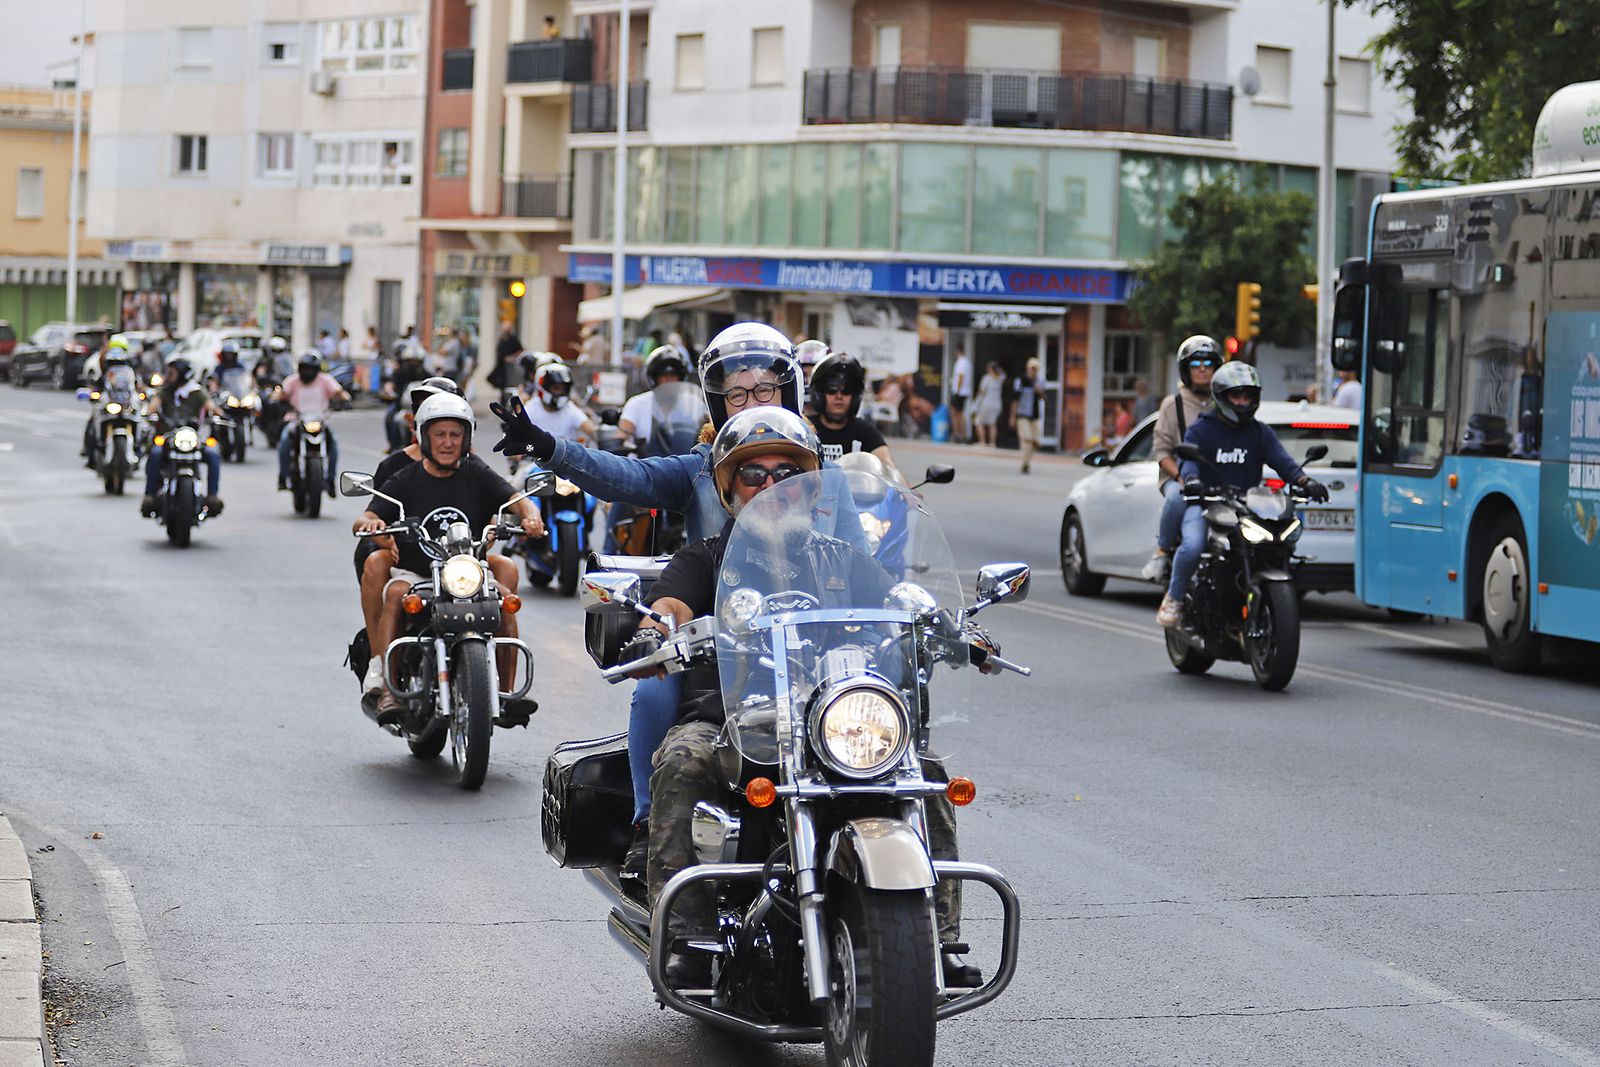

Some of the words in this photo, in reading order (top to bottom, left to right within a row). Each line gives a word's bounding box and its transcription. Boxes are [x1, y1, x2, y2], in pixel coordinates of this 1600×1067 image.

[777, 259, 873, 292] Inmobiliaria
[905, 267, 1006, 293] HUERTA
[1009, 271, 1112, 296] GRANDE
[1309, 514, 1340, 526] 0704
